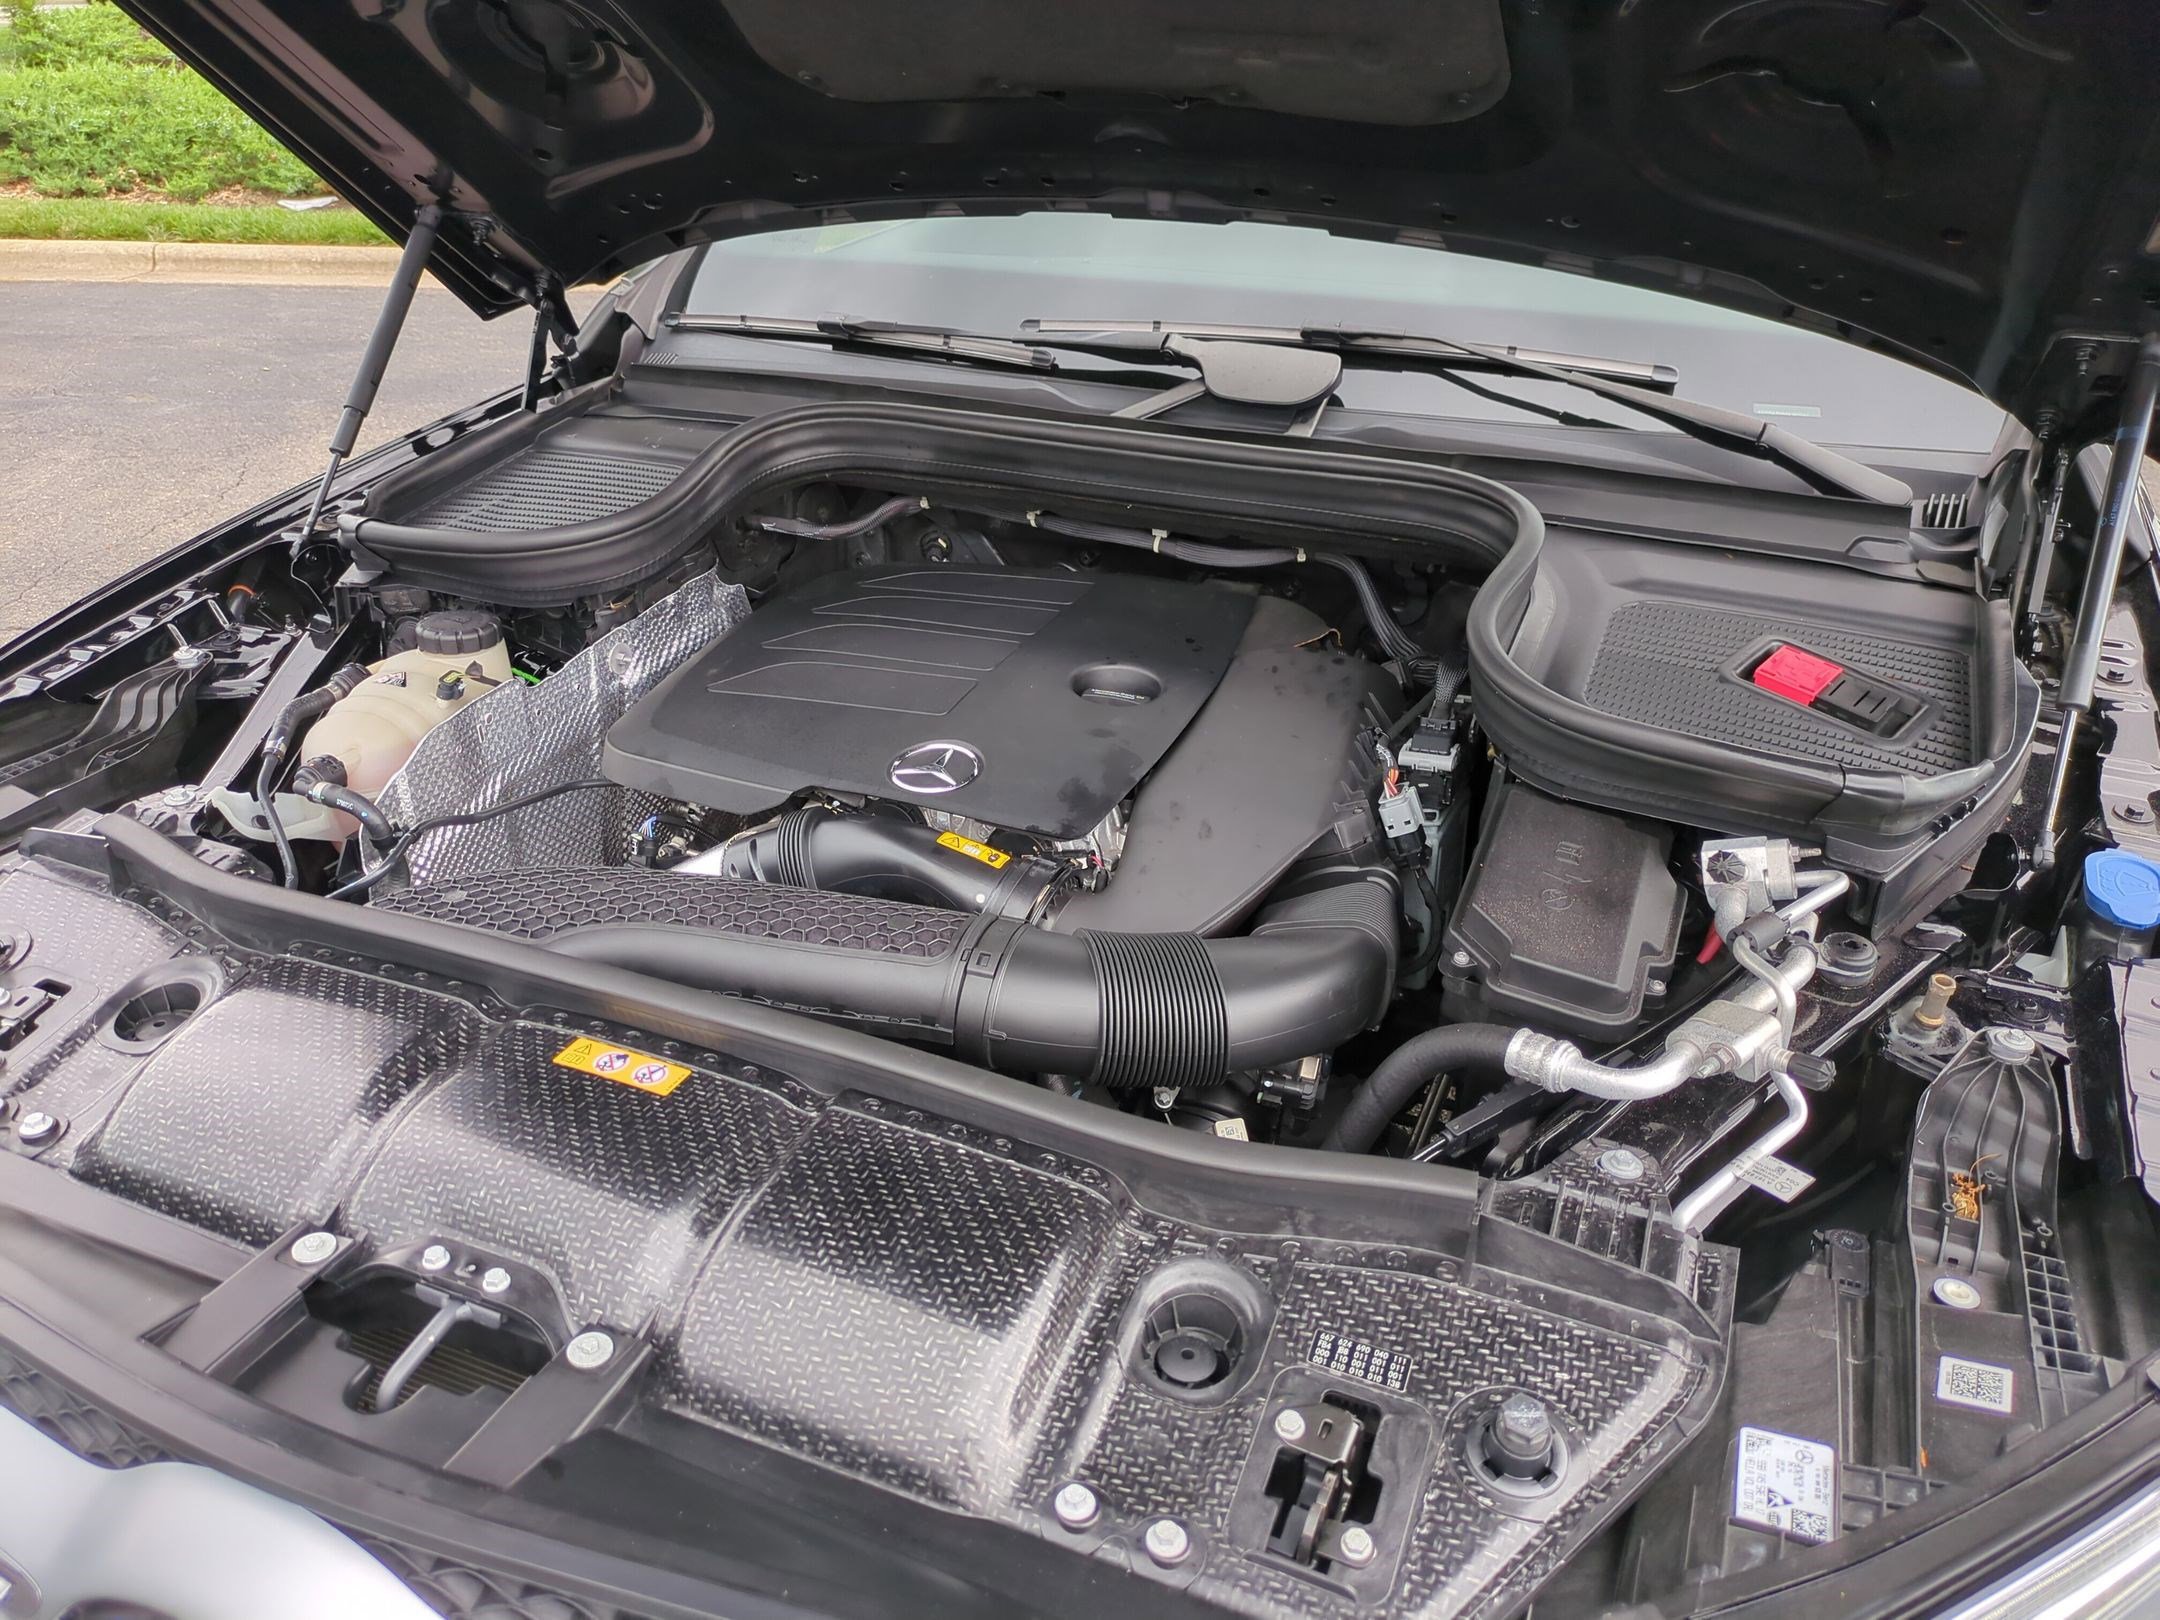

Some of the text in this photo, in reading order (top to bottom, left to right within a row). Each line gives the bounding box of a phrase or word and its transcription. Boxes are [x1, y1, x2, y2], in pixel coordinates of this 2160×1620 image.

[1315, 1348, 1402, 1380] 000 110 001 011 001
[1318, 1341, 1331, 1350] FB4
[1354, 1351, 1368, 1361] 011
[1372, 1357, 1386, 1367] 001
[1390, 1363, 1404, 1372] 011
[1320, 1333, 1407, 1365] 667 624 690 040 111
[1313, 1355, 1400, 1388] 001 010 010 010 138
